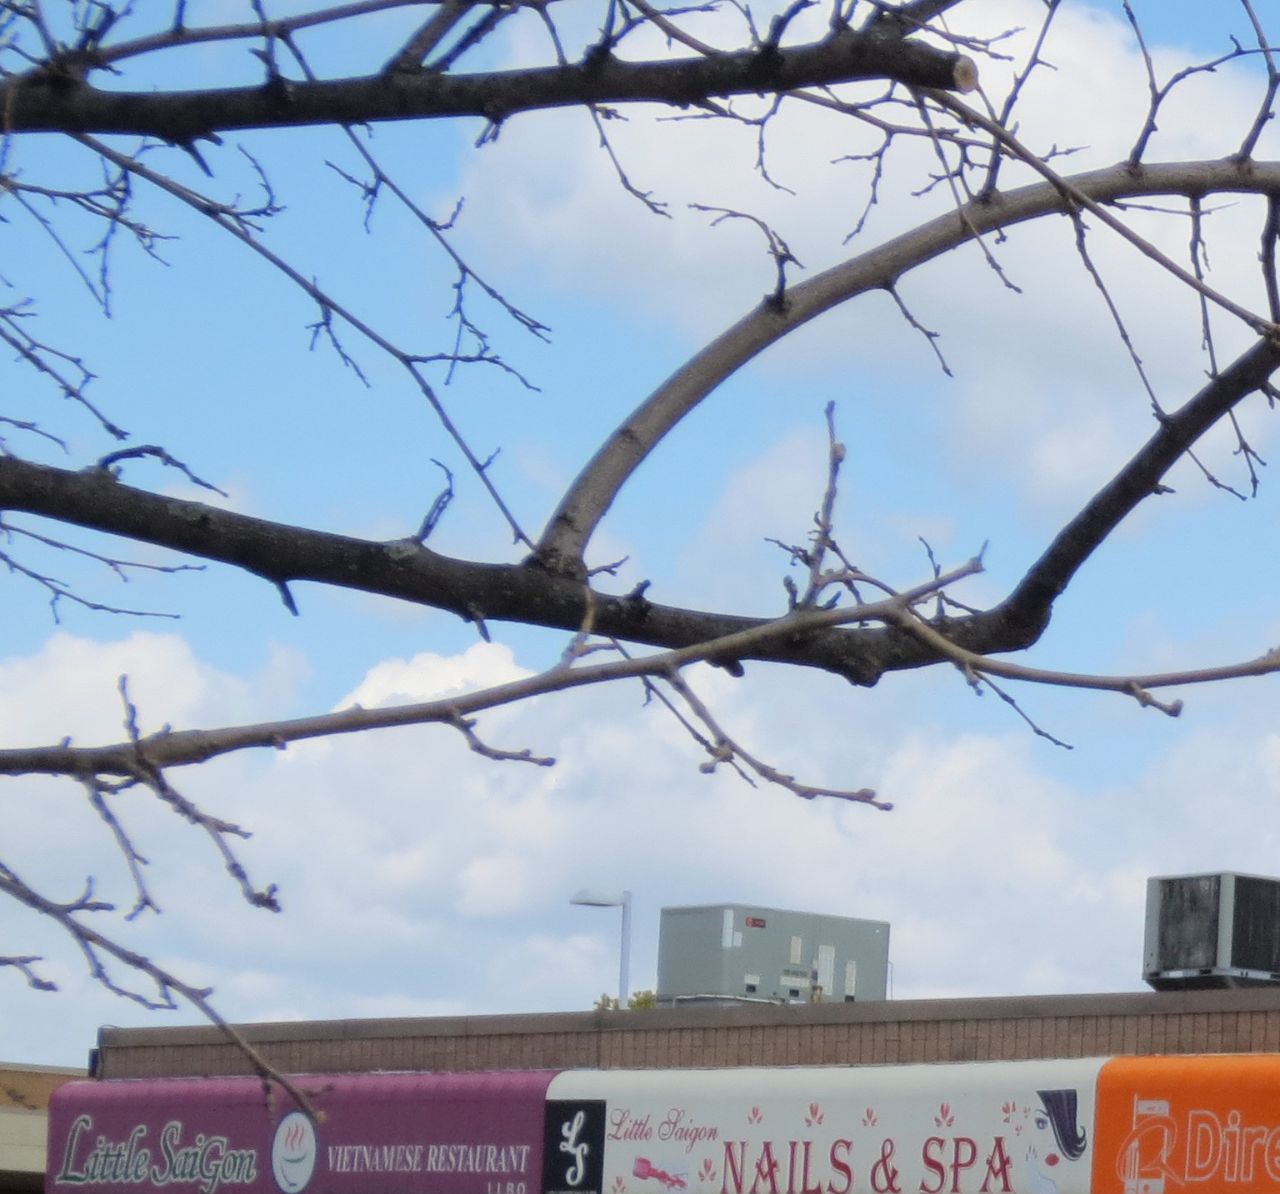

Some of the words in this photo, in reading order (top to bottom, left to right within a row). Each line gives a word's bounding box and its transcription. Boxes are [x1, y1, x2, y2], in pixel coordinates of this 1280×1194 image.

[55, 1114, 148, 1184] Little
[607, 1108, 653, 1140] Little
[658, 1108, 719, 1153] Saigon
[328, 1146, 422, 1172] VIETNAMESE
[427, 1144, 530, 1173] RESTAURANT
